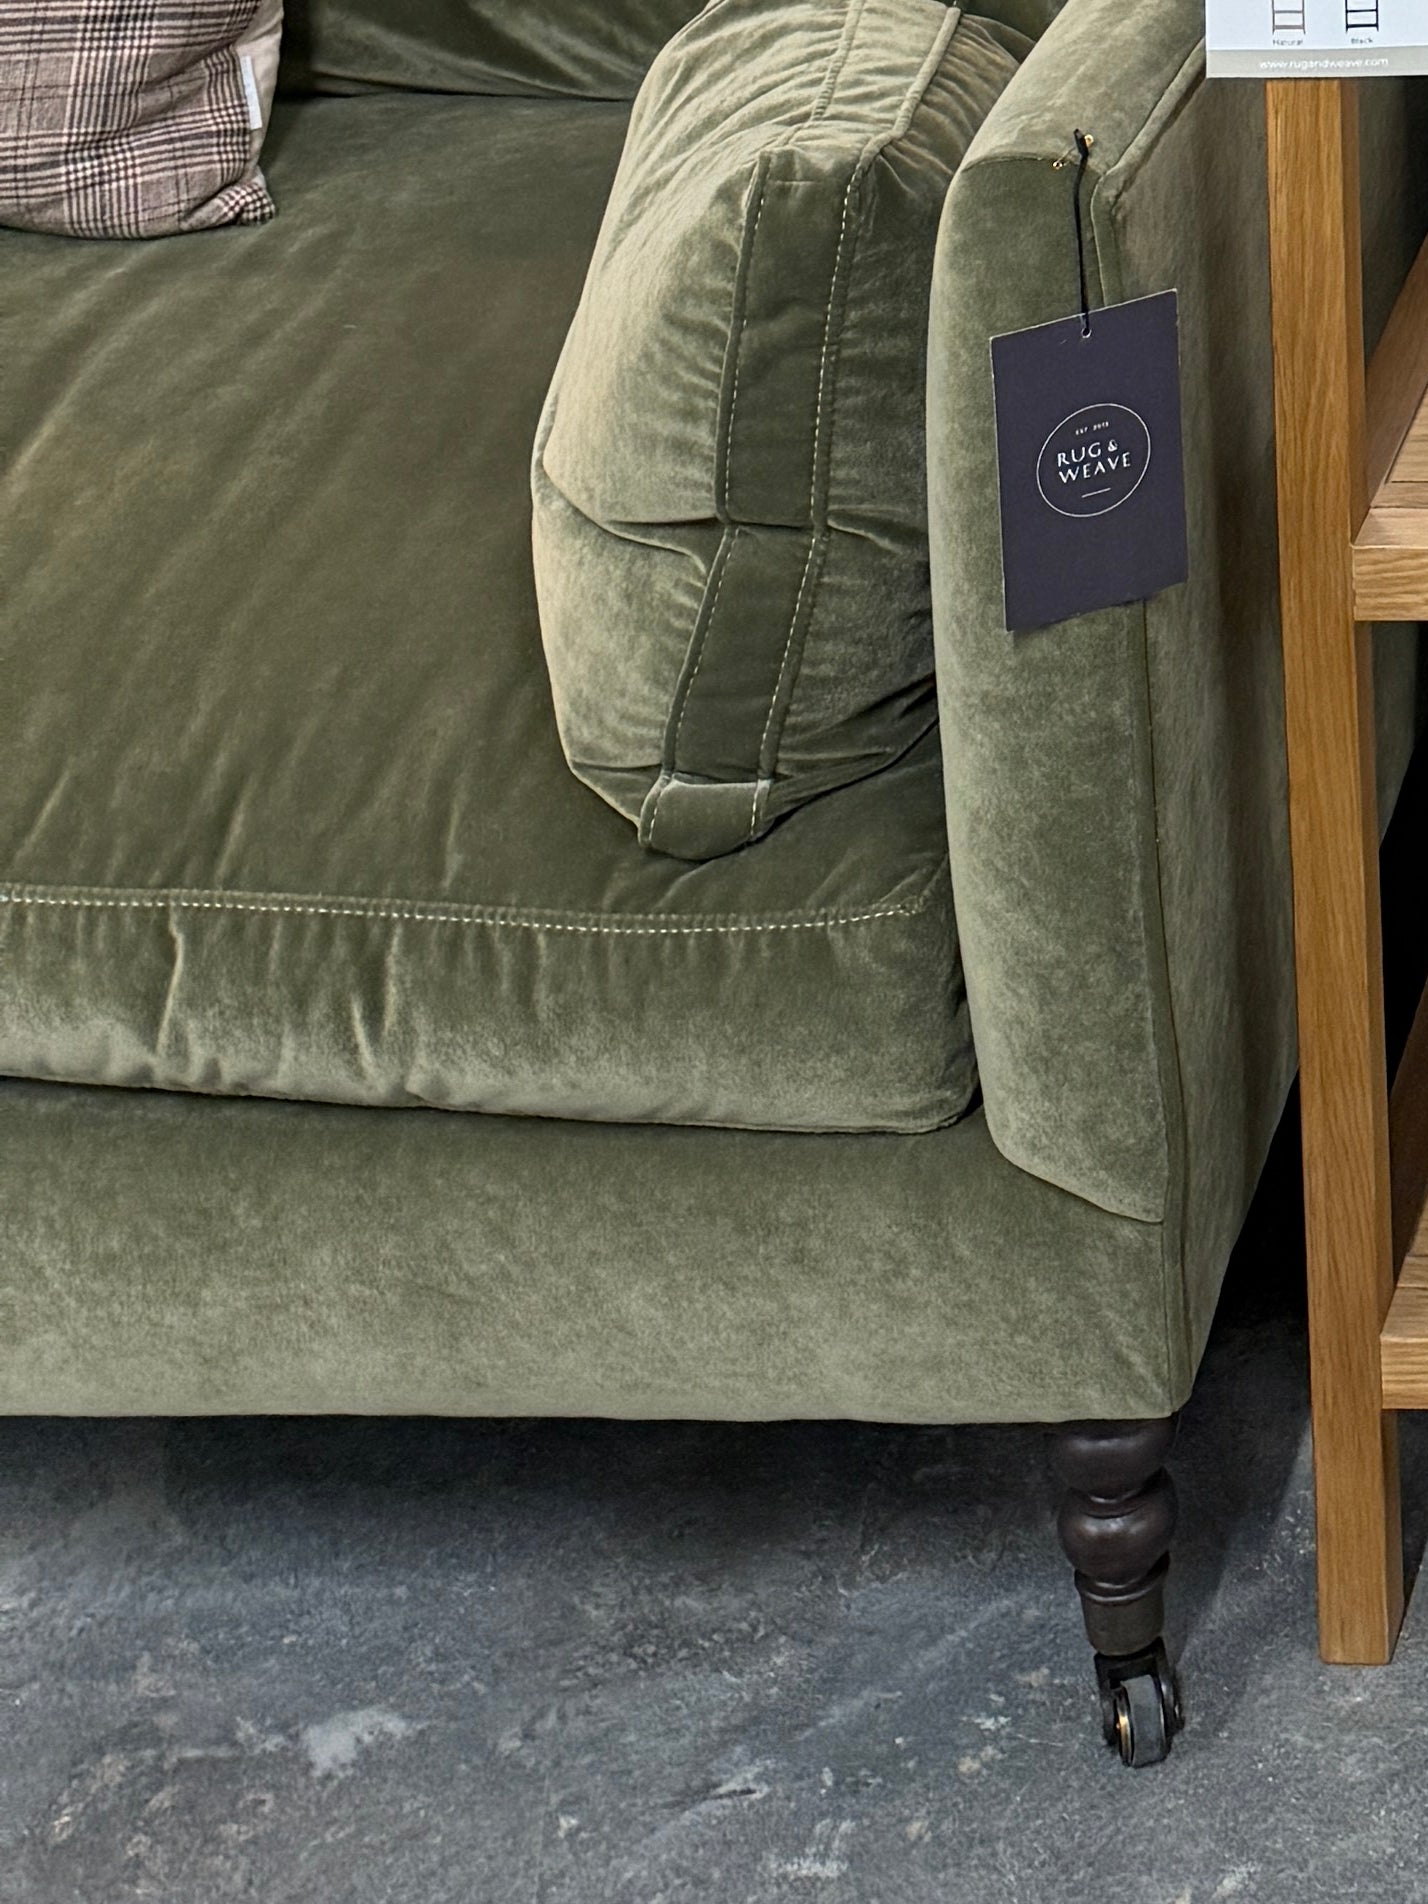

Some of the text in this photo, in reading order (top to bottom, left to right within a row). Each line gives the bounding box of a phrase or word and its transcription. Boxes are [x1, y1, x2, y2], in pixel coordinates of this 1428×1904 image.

[1057, 438, 1118, 468] RUG &
[1058, 451, 1131, 484] WEAVE
